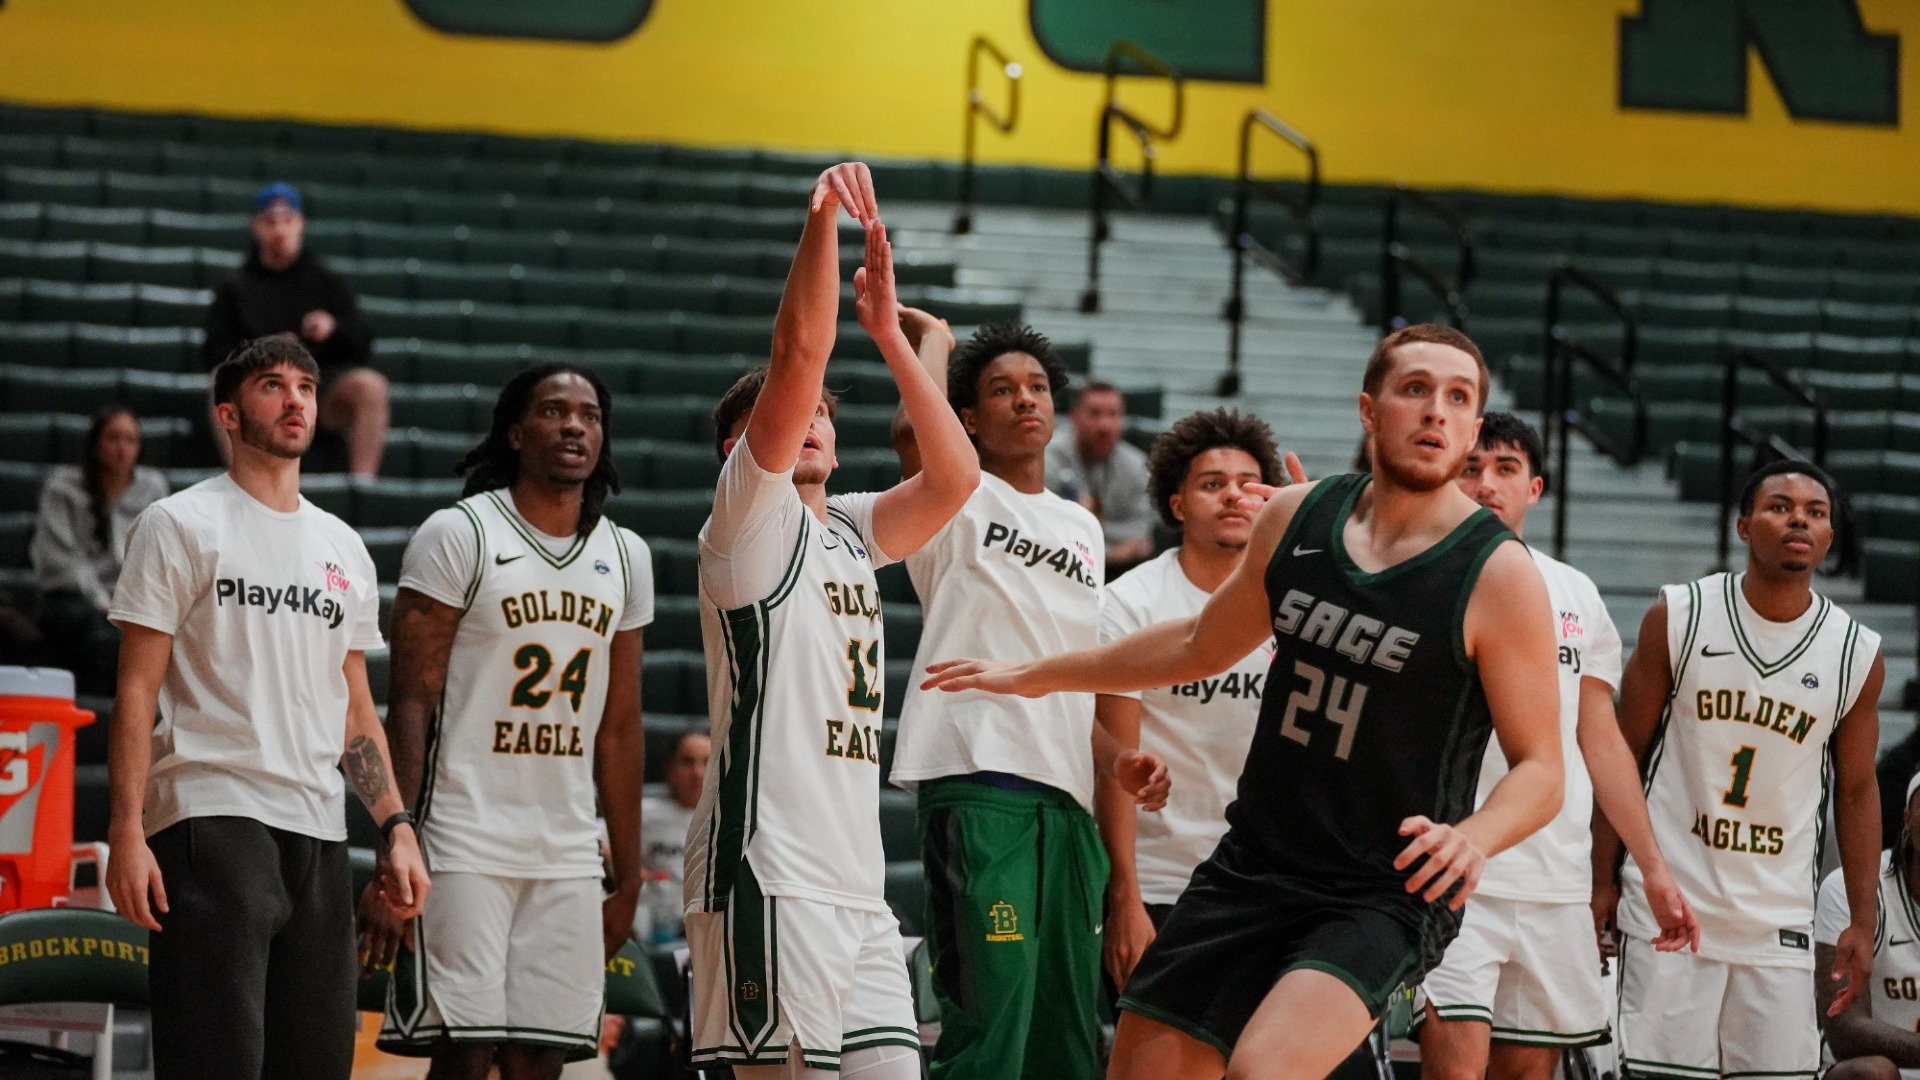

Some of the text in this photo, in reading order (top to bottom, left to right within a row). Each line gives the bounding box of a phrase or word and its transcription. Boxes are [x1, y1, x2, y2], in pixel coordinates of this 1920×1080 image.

[983, 522, 1099, 600] Play4Ka
[216, 578, 345, 629] Play4Kay
[500, 589, 614, 638] GOLDEN
[1274, 588, 1421, 673] SAGE
[509, 640, 593, 714] 24
[1280, 660, 1369, 761] 24
[1696, 688, 1818, 745] GOLDEN
[1721, 743, 1758, 811] 1
[0, 936, 150, 966] BROCKPORT
